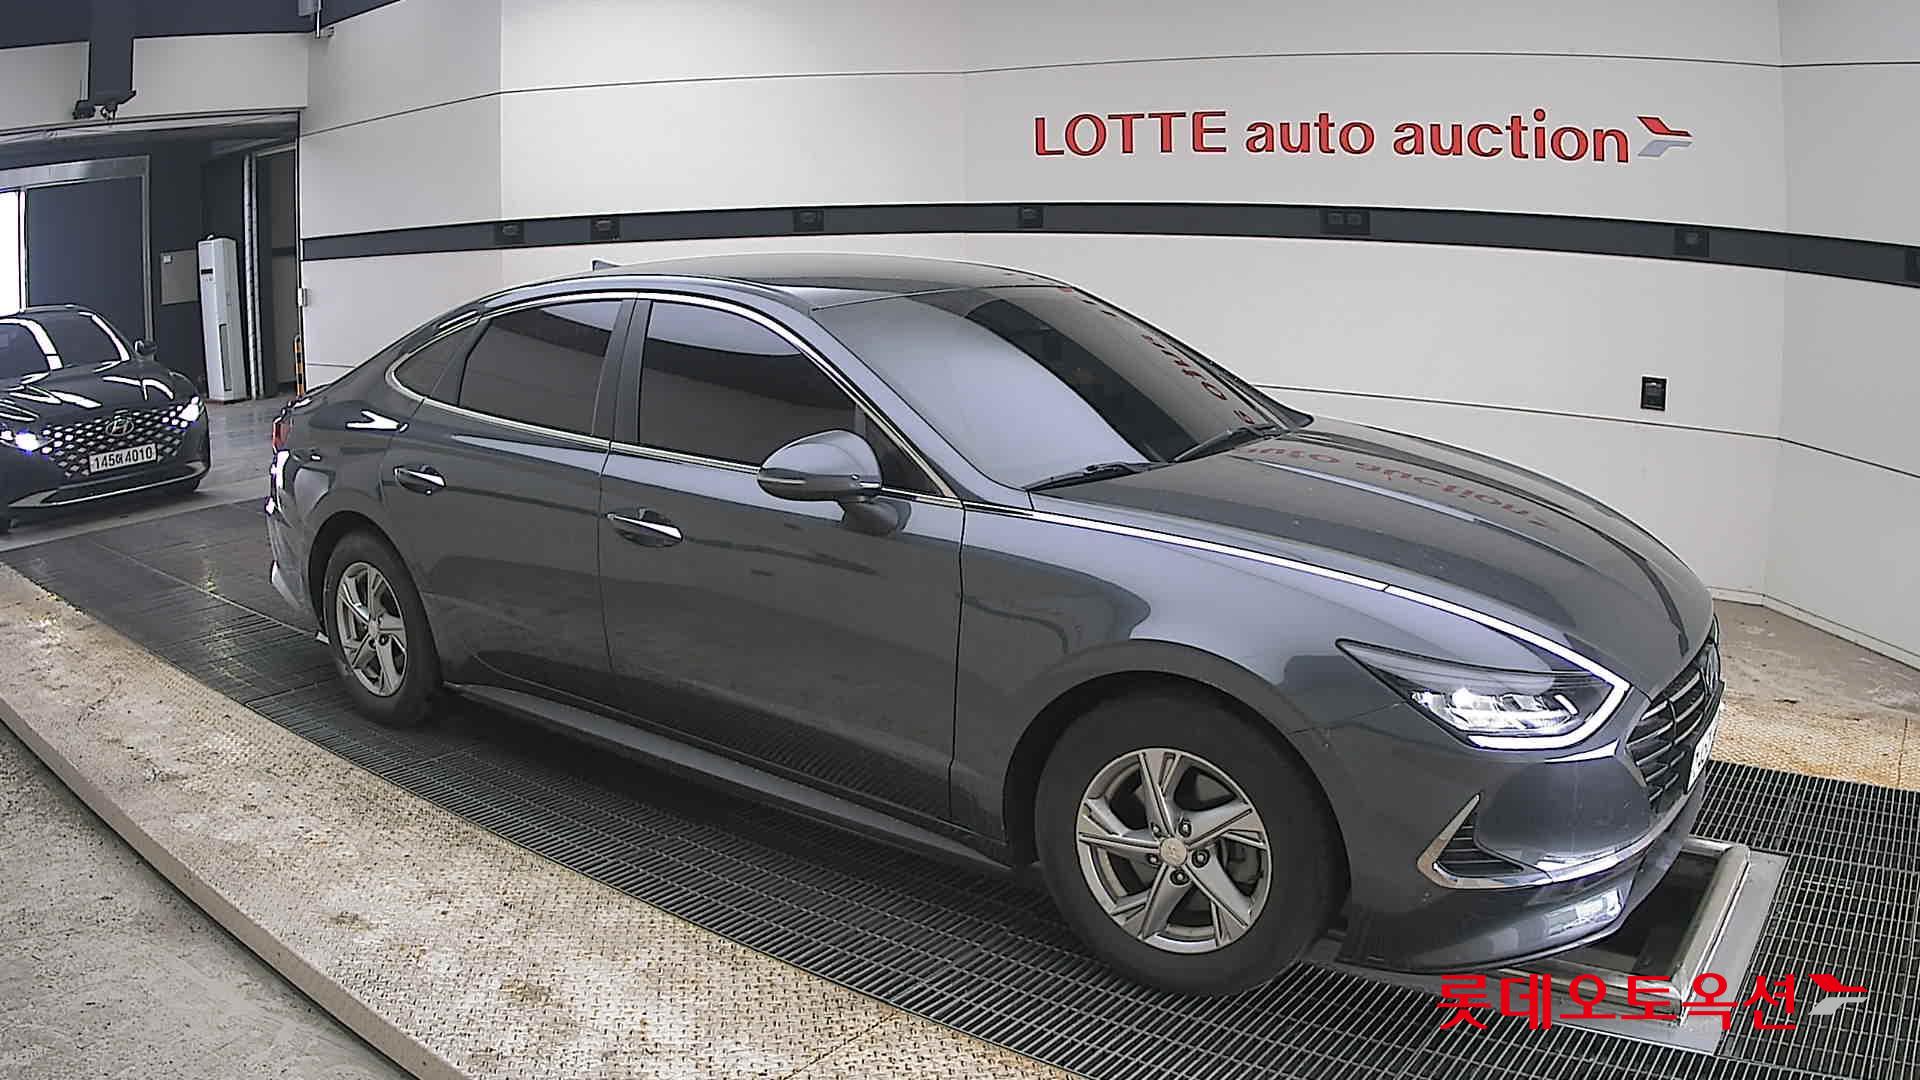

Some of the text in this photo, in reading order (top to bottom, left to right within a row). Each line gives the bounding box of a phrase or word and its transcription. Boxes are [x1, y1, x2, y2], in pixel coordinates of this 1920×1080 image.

[1034, 110, 1630, 162] LOTTE auto auction
